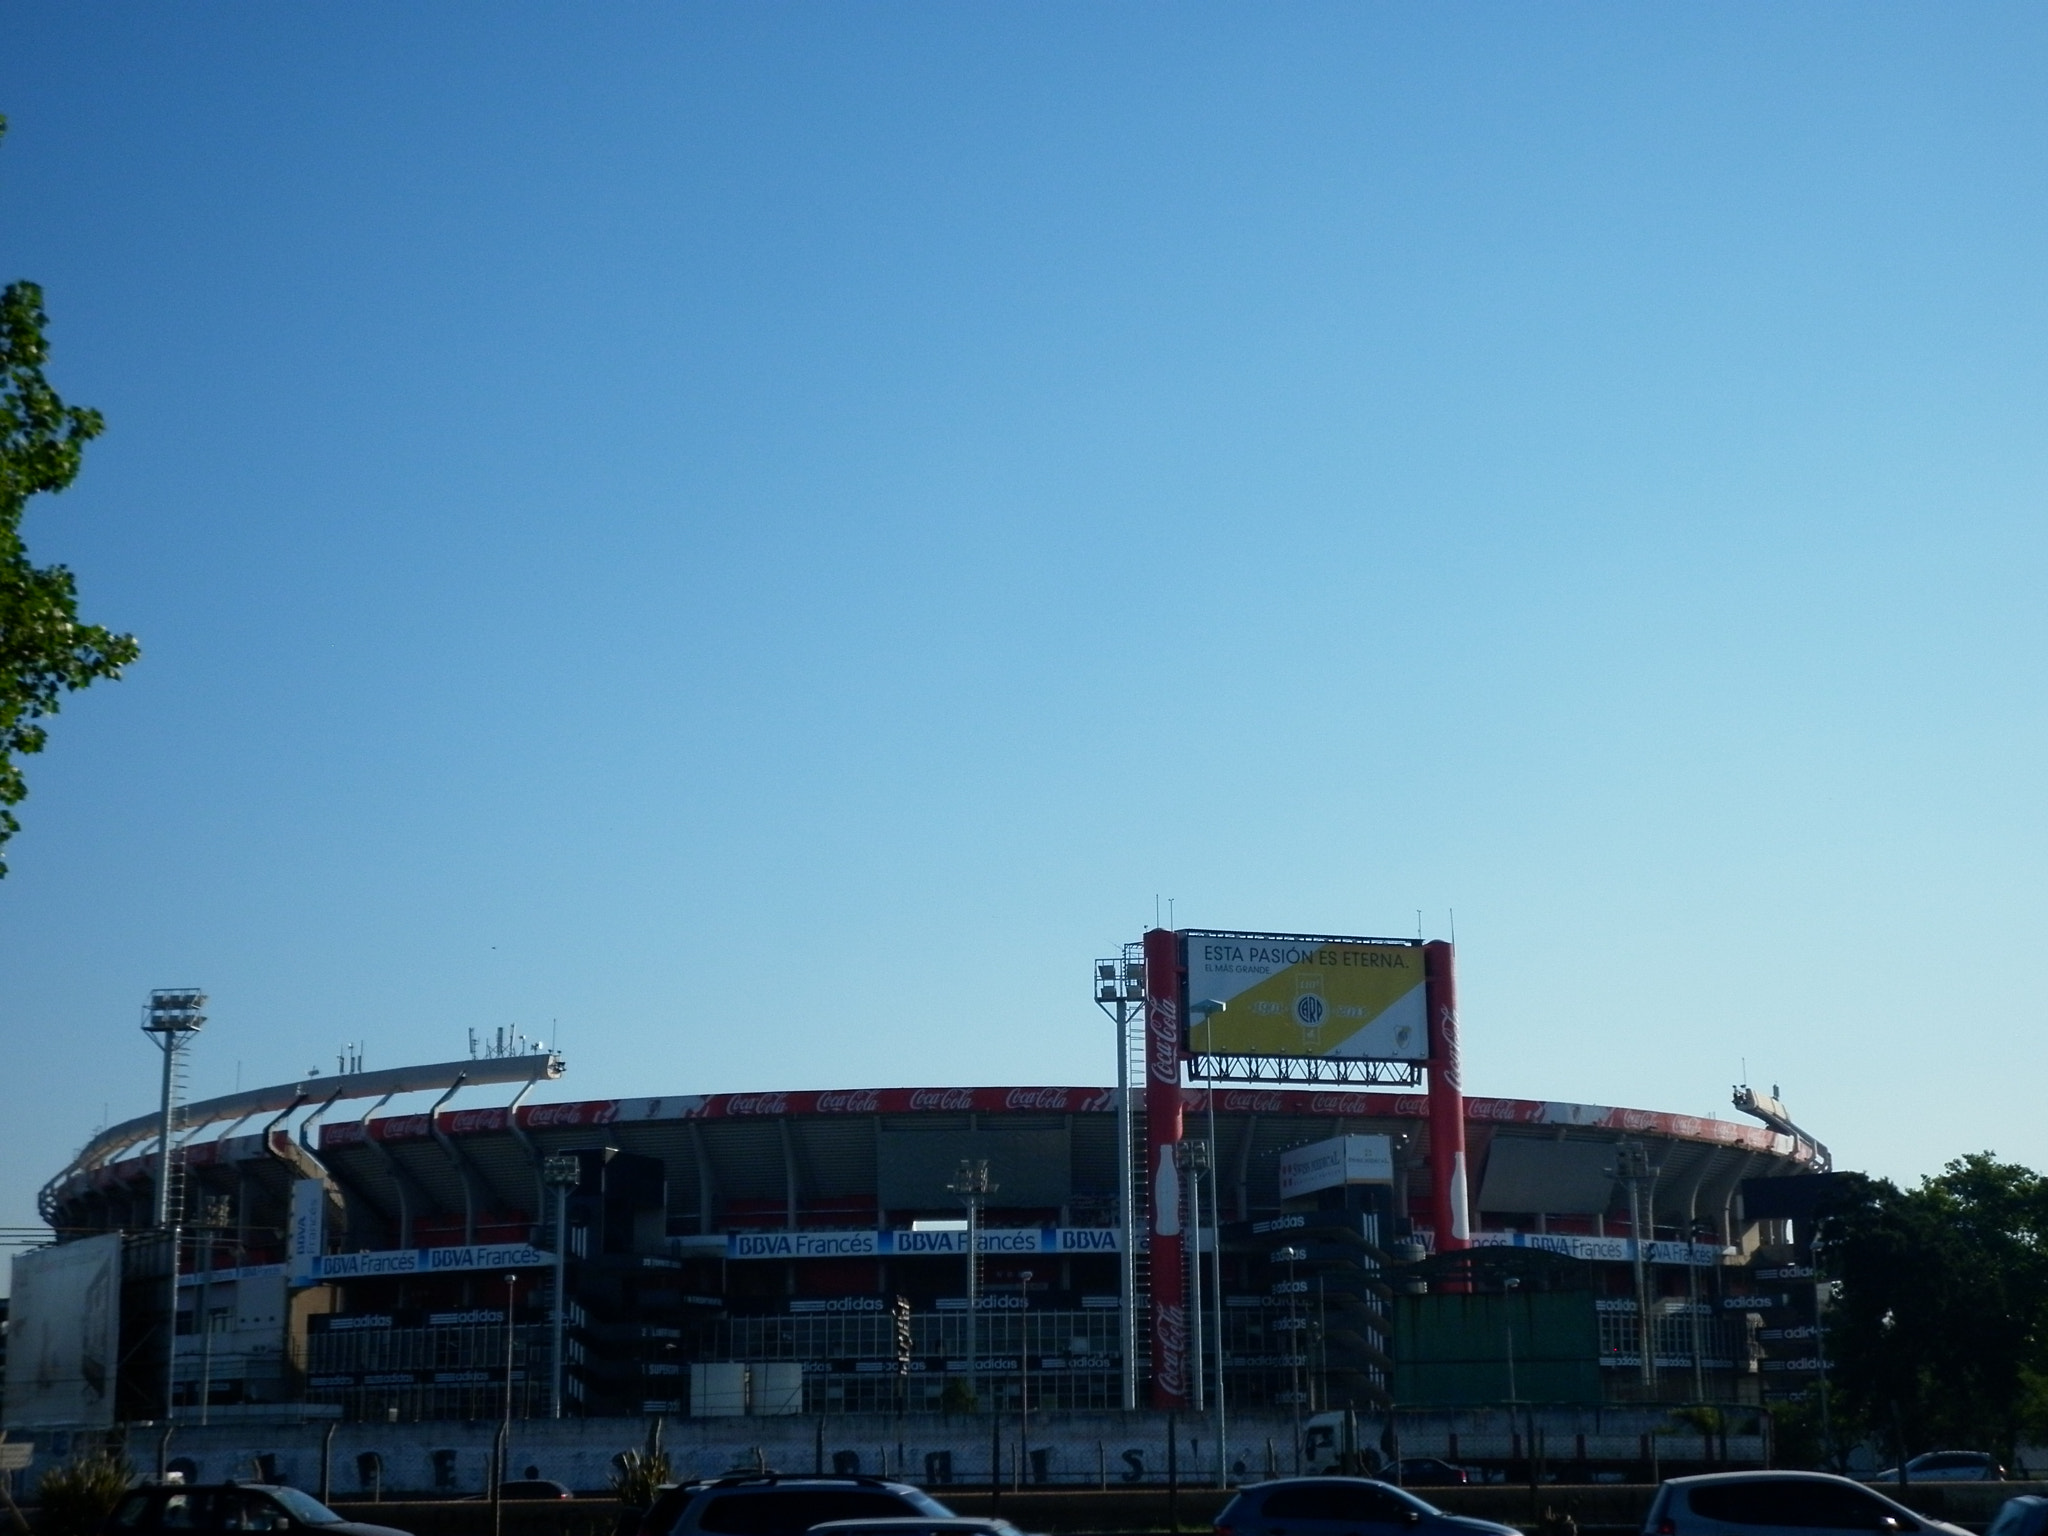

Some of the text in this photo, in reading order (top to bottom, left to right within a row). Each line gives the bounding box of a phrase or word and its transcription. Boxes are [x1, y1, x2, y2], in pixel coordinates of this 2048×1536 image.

[1204, 945, 1410, 969] ESTA PASIÓN ES ETERNA.
[1204, 964, 1216, 972] EL
[1216, 963, 1234, 974] MÁS
[1271, 1215, 1305, 1231] adidas
[739, 1233, 873, 1255] BBVA Francés
[900, 1231, 1036, 1250] BBVA Fancés
[1063, 1232, 1117, 1249] BBVA
[1572, 1239, 1623, 1258] Francés
[324, 1252, 415, 1275] BBVA Francés
[432, 1243, 540, 1268] BBVA Francés
[826, 1296, 884, 1311] adidas
[1724, 1296, 1772, 1308] adidas
[353, 1314, 393, 1328] adidas
[457, 1309, 504, 1323] adidas
[975, 1358, 1018, 1370] adidas
[1068, 1357, 1110, 1369] adidas
